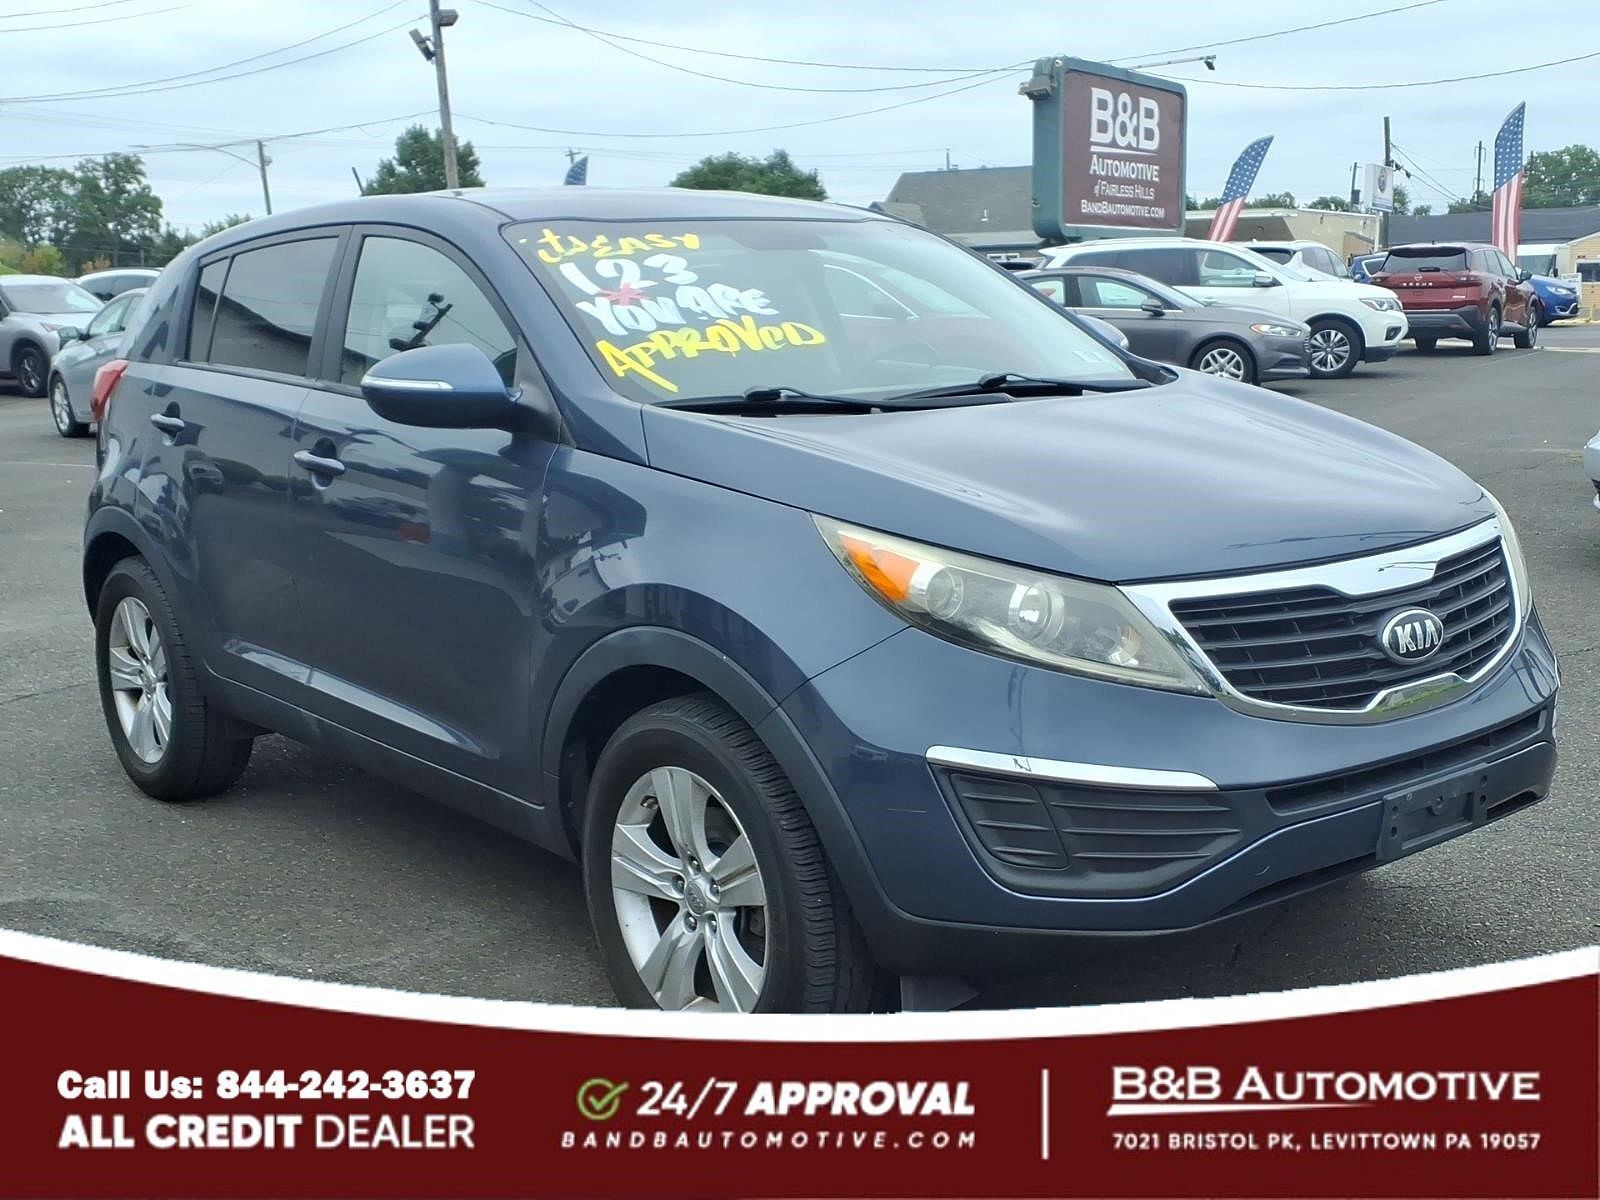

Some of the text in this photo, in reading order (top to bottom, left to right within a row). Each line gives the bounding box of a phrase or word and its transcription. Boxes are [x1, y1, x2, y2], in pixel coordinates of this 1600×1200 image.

[1090, 87, 1160, 151] B&B
[1089, 154, 1160, 182] AUTOMOTIVE
[1101, 181, 1134, 198] FAIRLESS
[1135, 184, 1155, 200] HILLS
[1080, 199, 1165, 218] BANDBAUTOMOTIVE.COM
[576, 283, 780, 336] YOU ARE
[1394, 618, 1439, 654] KIA
